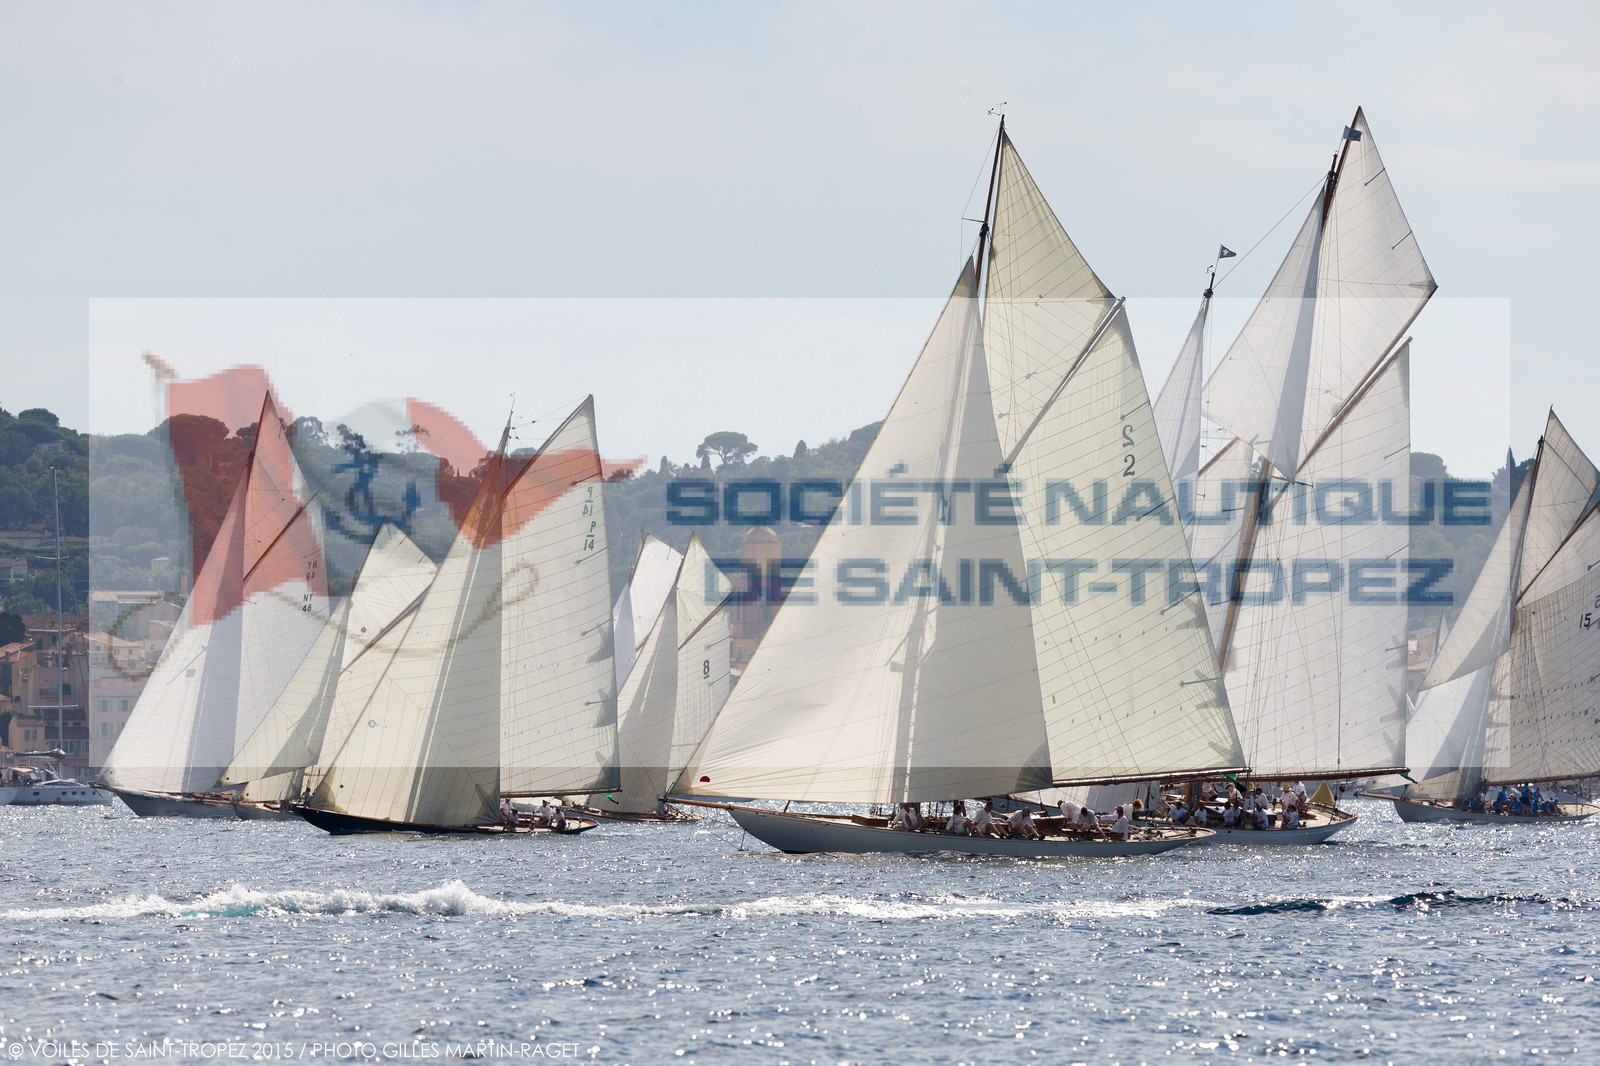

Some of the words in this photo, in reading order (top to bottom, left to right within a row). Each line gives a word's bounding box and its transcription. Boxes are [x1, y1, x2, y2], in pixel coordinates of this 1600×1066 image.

[1122, 454, 1136, 478] 2
[590, 521, 597, 533] P
[583, 538, 595, 551] 14
[303, 592, 313, 602] NY
[1579, 612, 1592, 629] 15
[703, 659, 710, 676] 8
